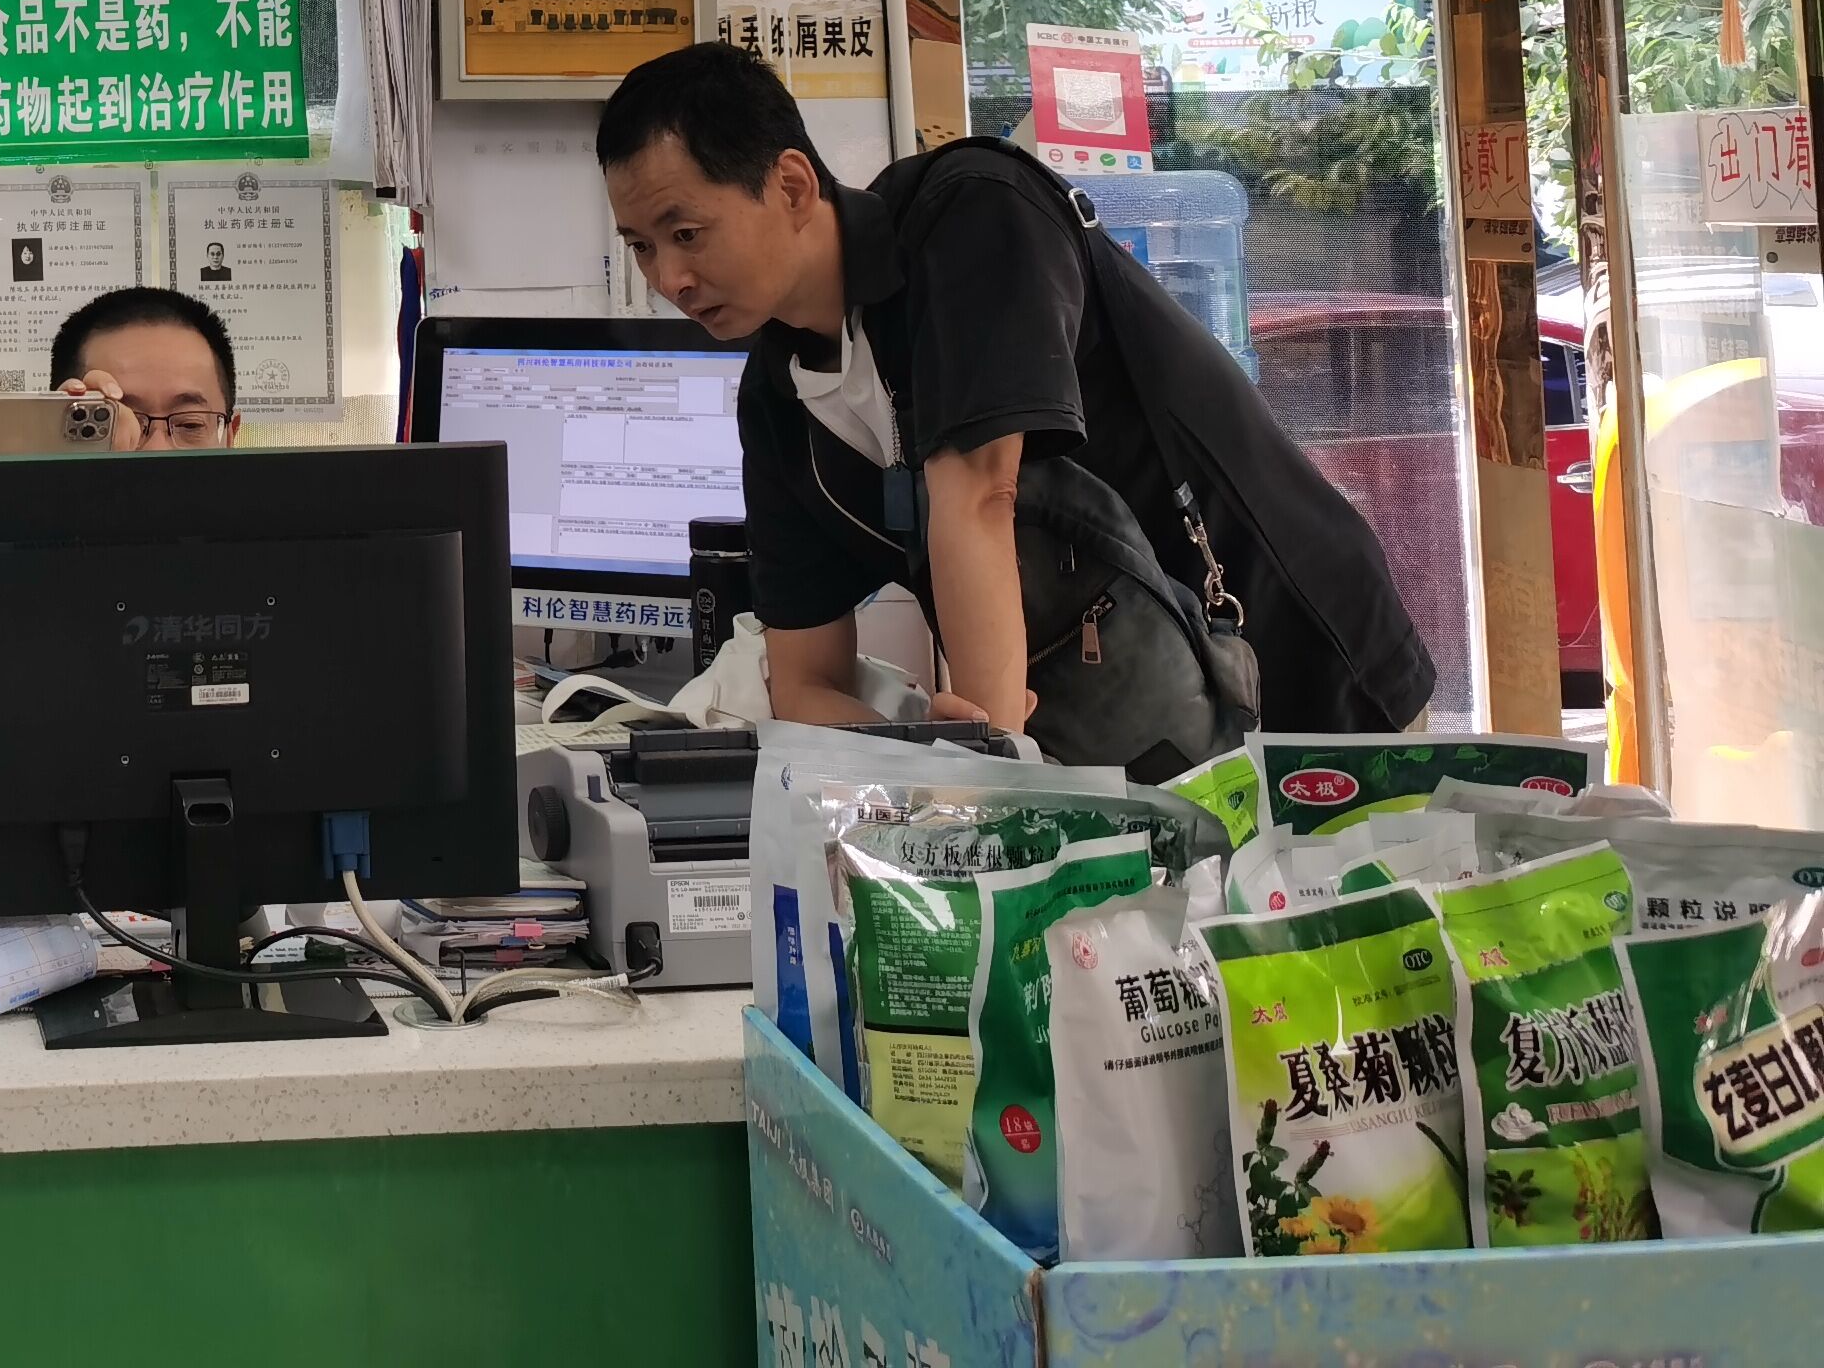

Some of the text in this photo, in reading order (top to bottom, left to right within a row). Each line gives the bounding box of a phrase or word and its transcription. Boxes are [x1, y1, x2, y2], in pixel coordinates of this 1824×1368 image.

[1719, 112, 1813, 189] 出门请
[31, 208, 92, 217] 中华人民共和国
[218, 206, 280, 215] 中华人民共和国
[16, 221, 107, 232] 执业药师注册证
[204, 218, 296, 229] 执业药师注册证
[154, 613, 273, 643] 清华同方
[1289, 781, 1338, 798] 太极
[1793, 869, 1824, 886] OT
[1404, 951, 1431, 970] OTC
[1115, 960, 1220, 1022] 葡萄糖
[1251, 1001, 1288, 1024] 太极
[1141, 1017, 1200, 1043] Glucose
[1280, 1014, 1459, 1122] 夏桑菊颗粒
[751, 1101, 781, 1150] TAIJI
